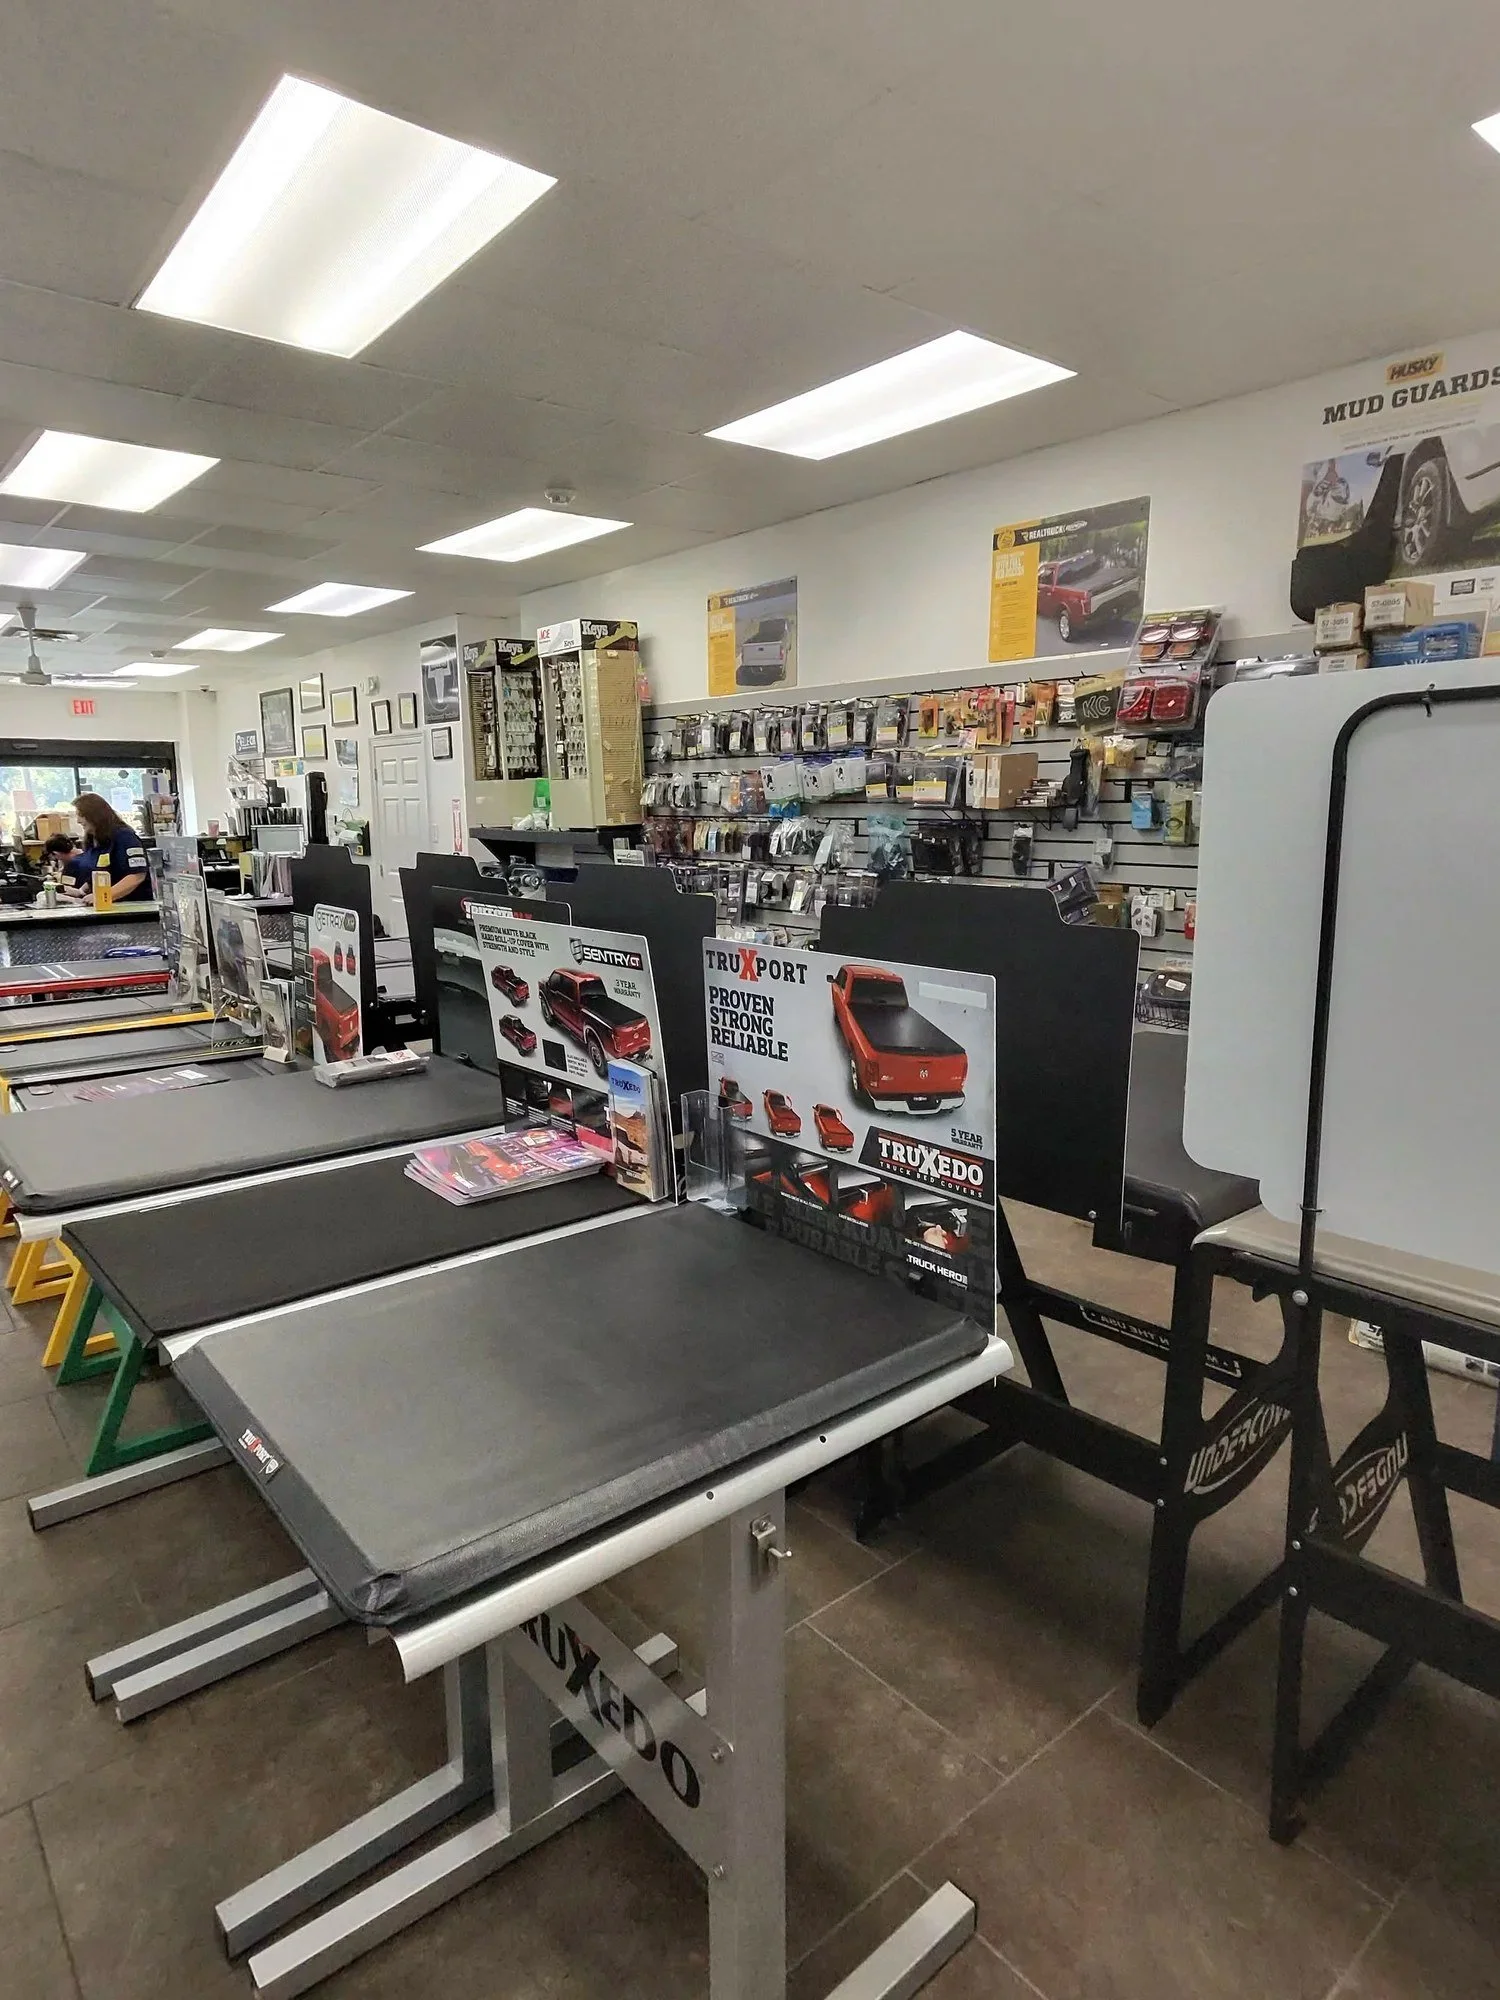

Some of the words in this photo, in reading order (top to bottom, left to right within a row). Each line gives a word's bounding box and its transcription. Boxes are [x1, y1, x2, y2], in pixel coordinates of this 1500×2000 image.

[1389, 355, 1439, 381] HUSKY
[1322, 394, 1384, 425] MUD
[1028, 525, 1065, 541] REALTRUCK
[540, 628, 550, 640] ACE
[581, 621, 608, 639] Keys
[463, 645, 479, 662] Keys
[497, 640, 523, 655] Keys
[73, 699, 94, 715] EXIT
[1082, 695, 1110, 719] KC
[479, 923, 501, 935] PREMIUM
[501, 928, 519, 937] MATTE
[519, 930, 537, 940] BLACK
[481, 932, 495, 941] HARD
[495, 935, 517, 945] ROLL-UP
[516, 939, 535, 949] COVER
[534, 942, 550, 951] WITH
[483, 941, 508, 952] STRENGTH
[508, 946, 519, 954] AND
[519, 948, 536, 957] STYLE
[583, 947, 630, 966] SENTRY
[630, 956, 640, 967] CT
[705, 947, 808, 984] TRUXPORT
[613, 987, 641, 999] WARRANTY
[615, 979, 620, 987] 3
[620, 980, 636, 990] YEAR
[709, 985, 775, 1016] PROVEN
[710, 1006, 774, 1037] STRONG
[710, 1025, 789, 1062] RELIABLE
[611, 1077, 641, 1094] TRUXEDO
[950, 1128, 957, 1137] 5
[958, 1129, 983, 1145] YEAR
[950, 1136, 983, 1151] WARRANTY
[878, 1137, 984, 1186] TRUXEDO
[880, 1161, 911, 1176] TRUCK
[916, 1172, 935, 1184] BED
[940, 1181, 983, 1198] COVERS
[907, 1254, 936, 1272] TRUCK
[937, 1265, 963, 1282] HERO
[241, 1428, 271, 1464] TRUXPORT
